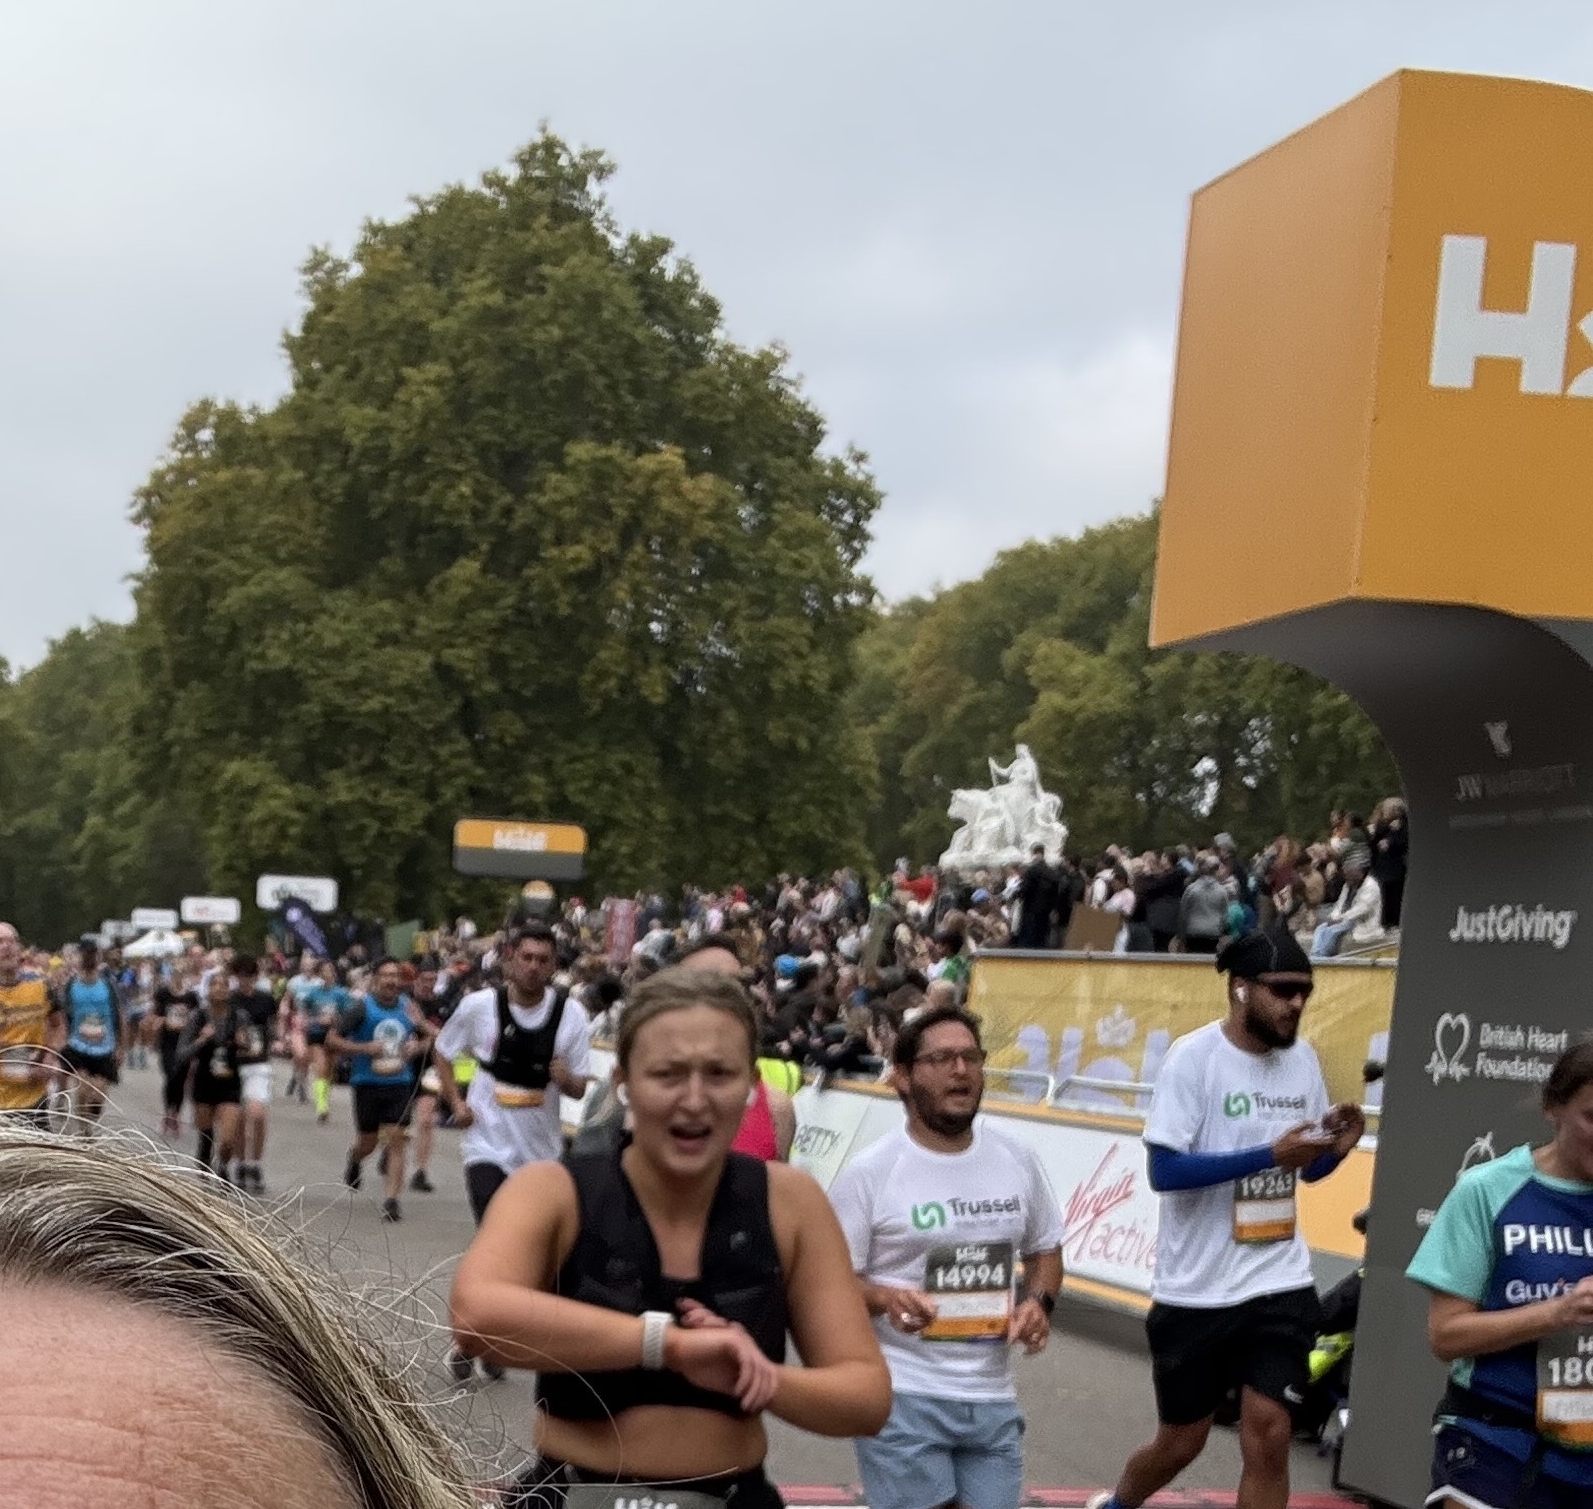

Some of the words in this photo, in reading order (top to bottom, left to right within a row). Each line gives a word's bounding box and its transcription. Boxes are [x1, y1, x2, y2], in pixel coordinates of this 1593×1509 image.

[1428, 233, 1593, 398] H
[1449, 904, 1578, 949] JustGiving
[1479, 1023, 1524, 1050] British
[1527, 1025, 1568, 1053] Heart
[1062, 1143, 1135, 1245] Virgin
[936, 1263, 1005, 1290] 14994
